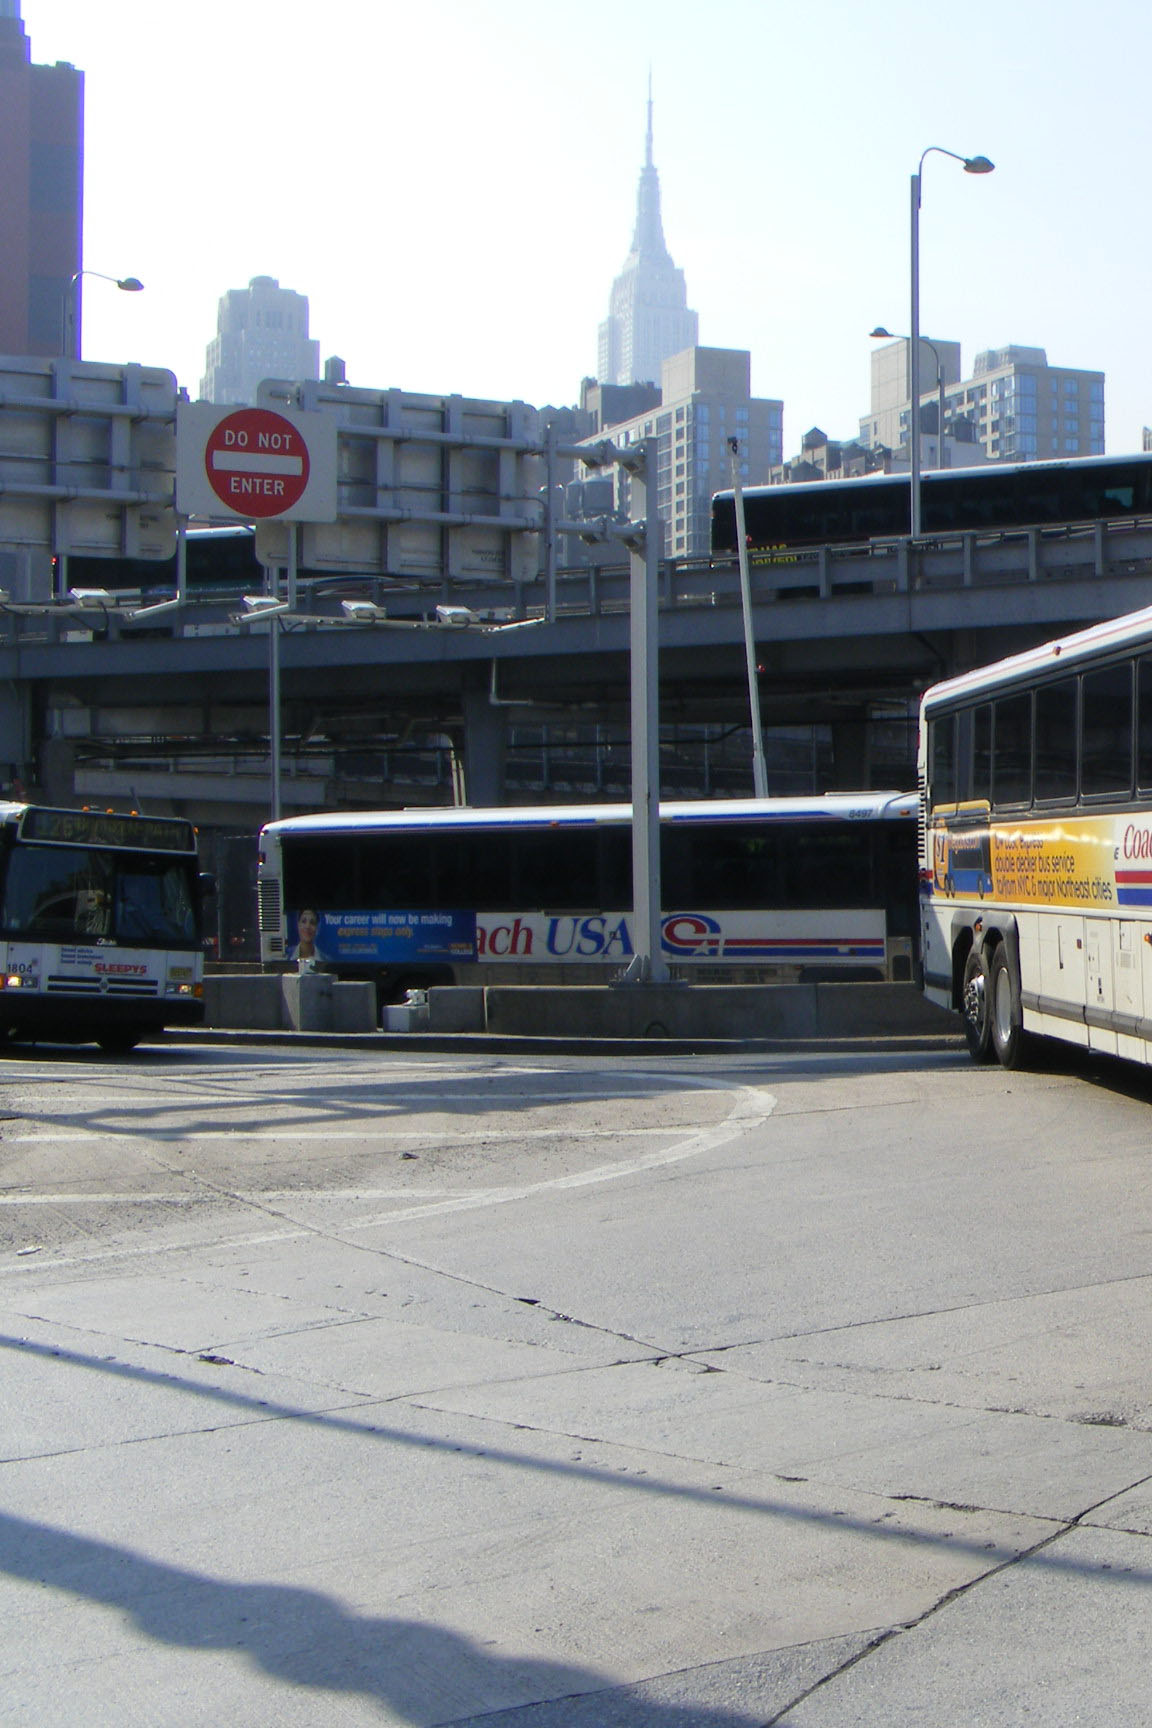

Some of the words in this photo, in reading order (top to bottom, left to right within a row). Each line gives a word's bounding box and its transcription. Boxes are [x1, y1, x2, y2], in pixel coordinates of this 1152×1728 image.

[224, 429, 249, 447] DO
[258, 431, 293, 450] NOT
[231, 477, 285, 496] ENTER
[994, 853, 1015, 873] double
[1016, 853, 1038, 874] decker
[1039, 853, 1051, 874] bus
[1051, 852, 1076, 874] service
[1017, 876, 1032, 897] NYC
[1037, 877, 1056, 902] major
[1056, 877, 1092, 900] Northeast
[1091, 878, 1113, 901] cities
[324, 914, 343, 925] Your
[344, 915, 369, 925] career
[372, 914, 387, 925] will
[388, 916, 407, 925] now
[408, 914, 419, 925] be
[421, 914, 453, 927] making
[546, 917, 635, 956] USA
